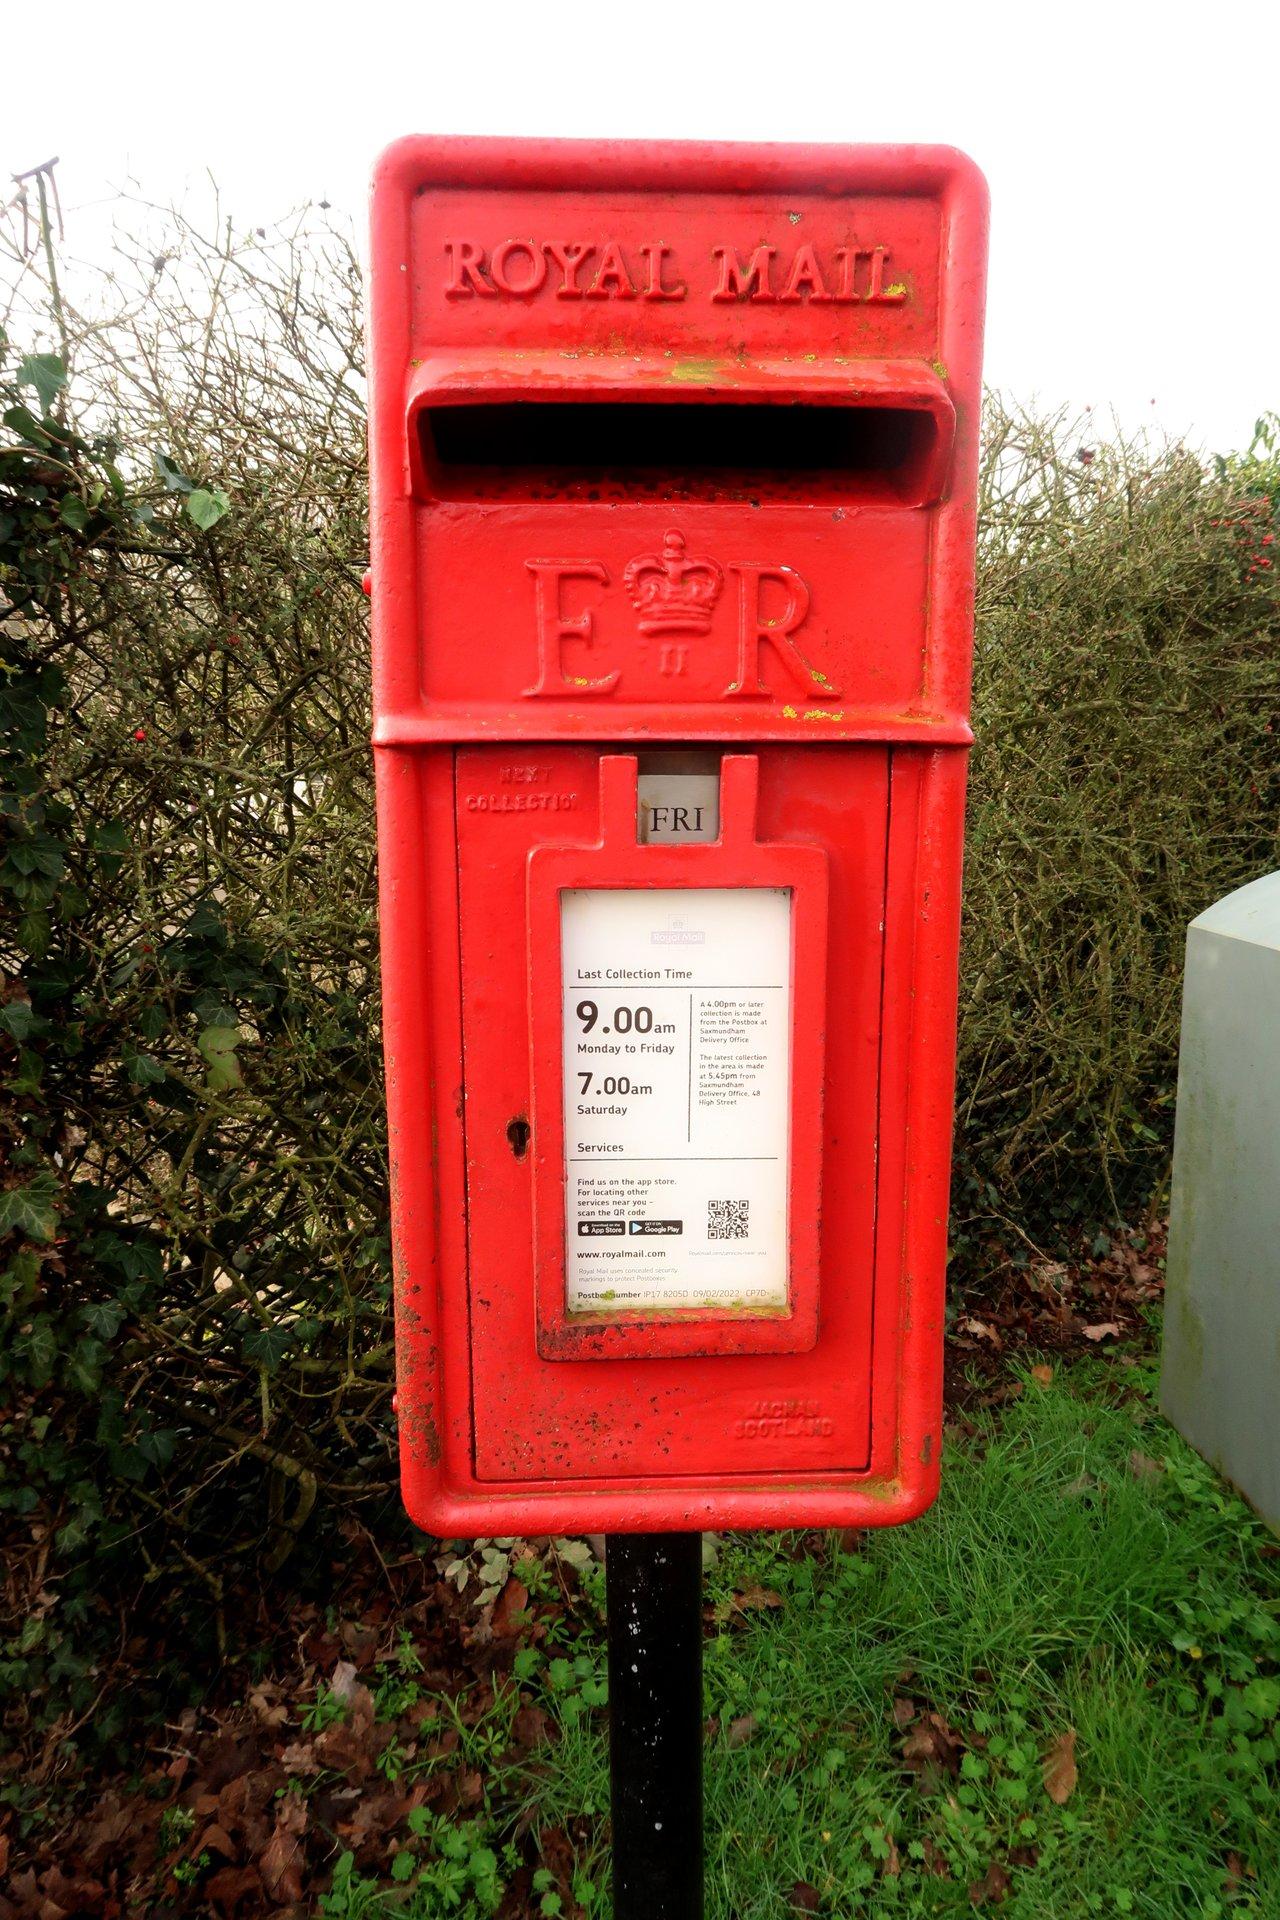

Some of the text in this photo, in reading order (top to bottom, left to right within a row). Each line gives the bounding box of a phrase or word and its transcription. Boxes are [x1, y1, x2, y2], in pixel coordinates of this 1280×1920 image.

[445, 237, 907, 305] ROYAL MAIL
[522, 557, 842, 701] E R
[465, 792, 577, 812] COLLECTIO
[650, 807, 705, 832] FRI
[577, 968, 693, 979] Last Collection Time
[707, 1000, 737, 1008] 4.00pm
[576, 1000, 676, 1034] 9.00am
[577, 1043, 675, 1055] Monday to Friday
[708, 1072, 737, 1080] 5.45pm
[577, 1072, 652, 1095] 7.00am
[577, 1104, 627, 1116] Saturday
[577, 1143, 624, 1152] Services
[637, 1180, 652, 1188] app
[593, 1189, 625, 1197] locating
[613, 1208, 625, 1216] QR
[577, 1250, 666, 1259] www.royalmail.com
[693, 1289, 740, 1298] 09/02/2022
